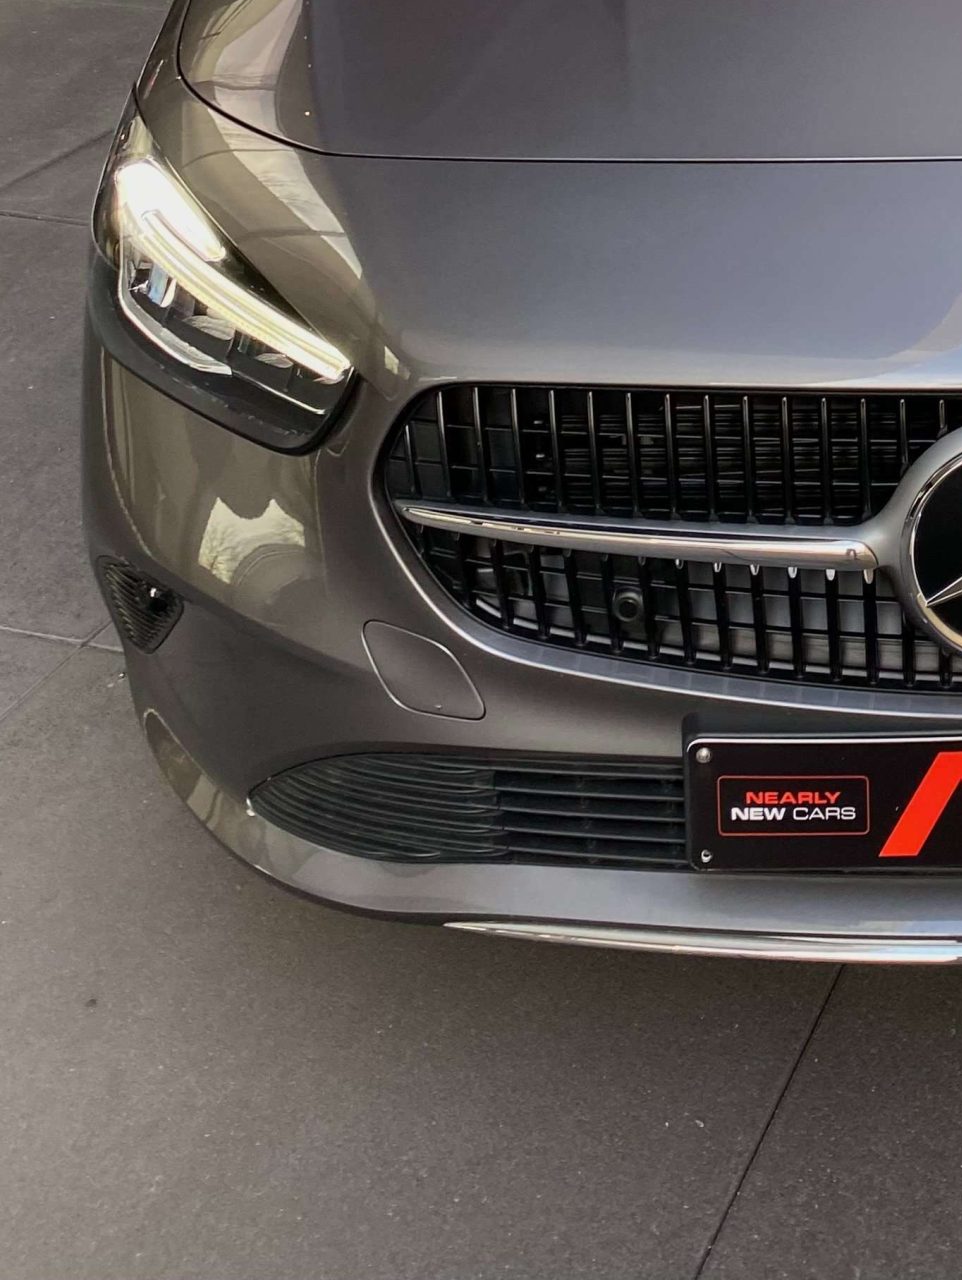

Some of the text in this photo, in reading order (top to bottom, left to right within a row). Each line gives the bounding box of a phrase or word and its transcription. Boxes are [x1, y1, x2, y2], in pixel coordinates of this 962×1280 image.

[746, 791, 841, 804] NEARLY
[731, 807, 856, 821] NEW CARS
